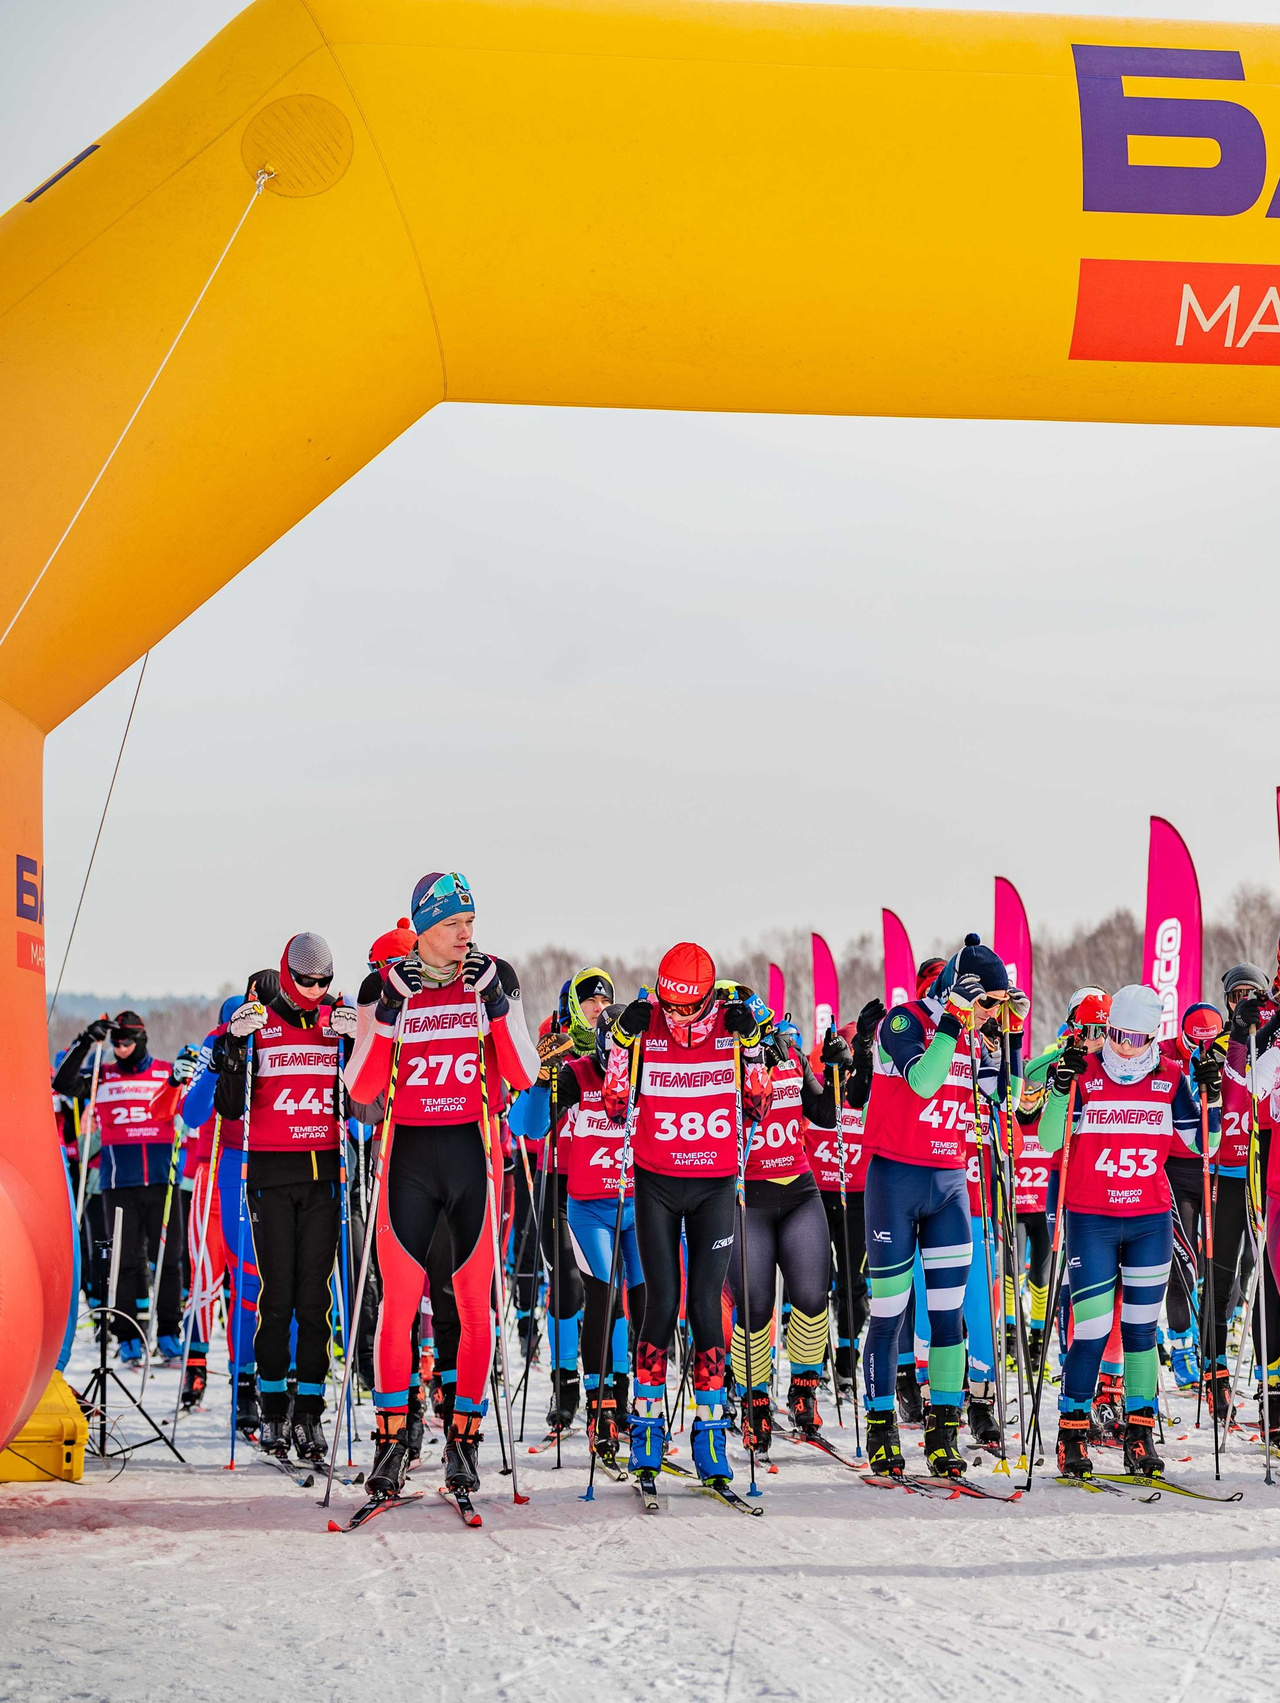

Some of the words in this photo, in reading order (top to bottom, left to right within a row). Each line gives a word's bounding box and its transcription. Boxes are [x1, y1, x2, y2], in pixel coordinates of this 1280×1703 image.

[405, 1052, 478, 1086] 276
[649, 1068, 734, 1088] ТЕМЕРСО
[420, 1097, 467, 1105] ТЕМЕРСО
[424, 1104, 464, 1113] АНГАРА
[1086, 1108, 1164, 1125] ТЕМЕРСО
[289, 1125, 328, 1133] ТЕМЕРСО
[654, 1108, 732, 1141] 386
[292, 1131, 326, 1139] АНГАРА
[589, 1146, 634, 1169] 49
[670, 1151, 718, 1159] ТЕМЕРСО
[814, 1141, 863, 1165] 437
[1094, 1148, 1158, 1178] 453
[1107, 1188, 1142, 1196] ТЕМЕРСО
[1109, 1195, 1140, 1204] АНГАРА
[1132, 1476, 1153, 1486] FISCHER
